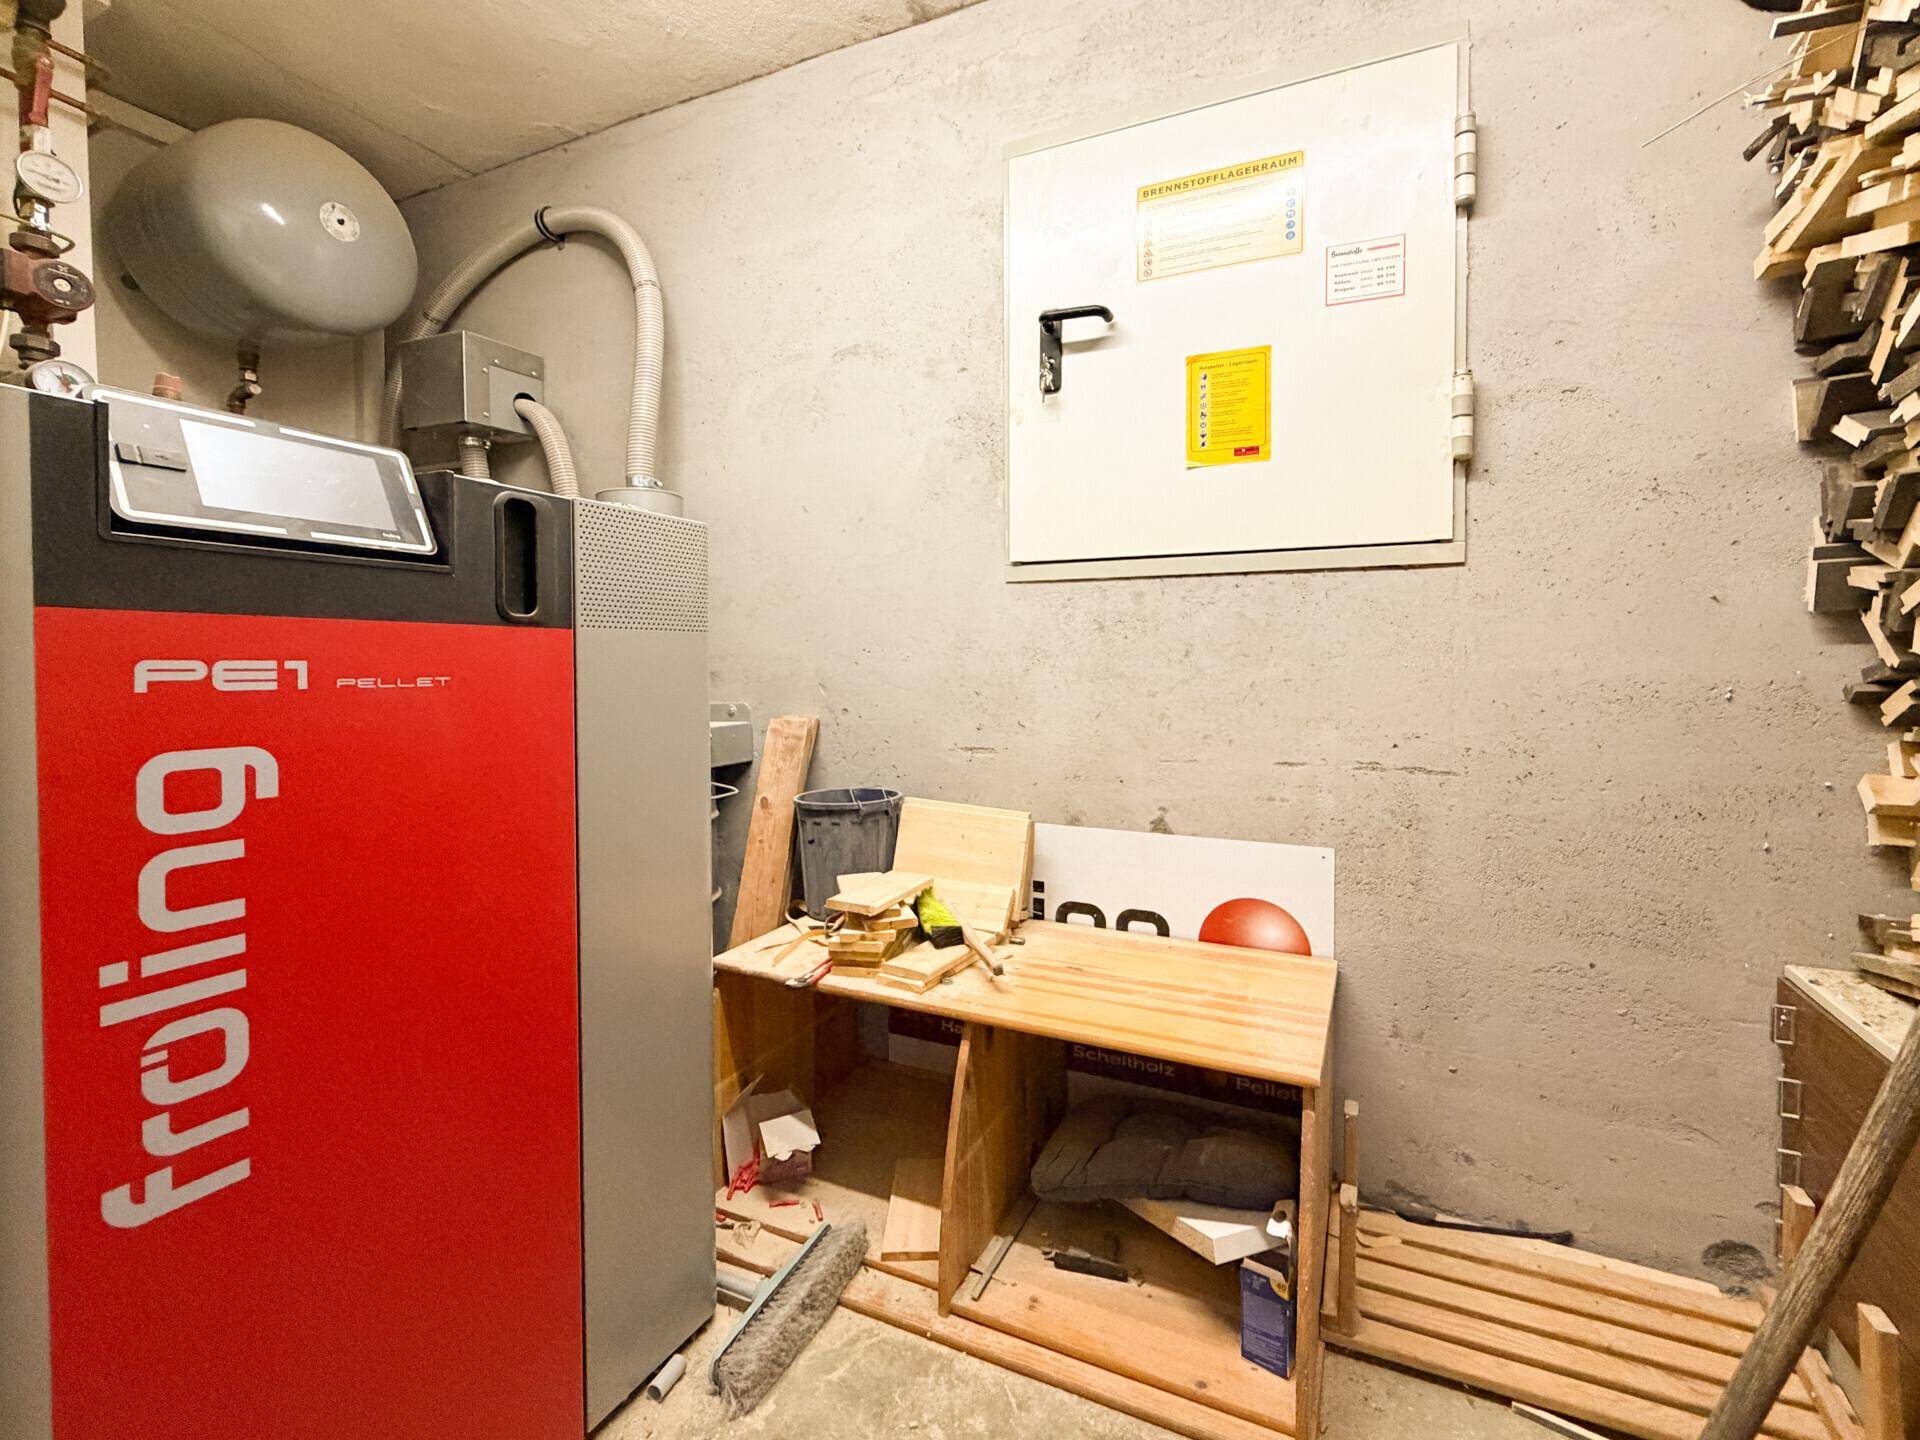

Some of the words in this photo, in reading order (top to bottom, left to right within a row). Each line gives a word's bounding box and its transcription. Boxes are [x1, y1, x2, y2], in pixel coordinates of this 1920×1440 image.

[1142, 156, 1298, 198] BRENNSTOFFLAGERRAUM
[133, 659, 308, 693] PE1
[336, 676, 451, 688] PELLET
[99, 745, 279, 1229] fröling
[1072, 1044, 1176, 1077] Scheitholz
